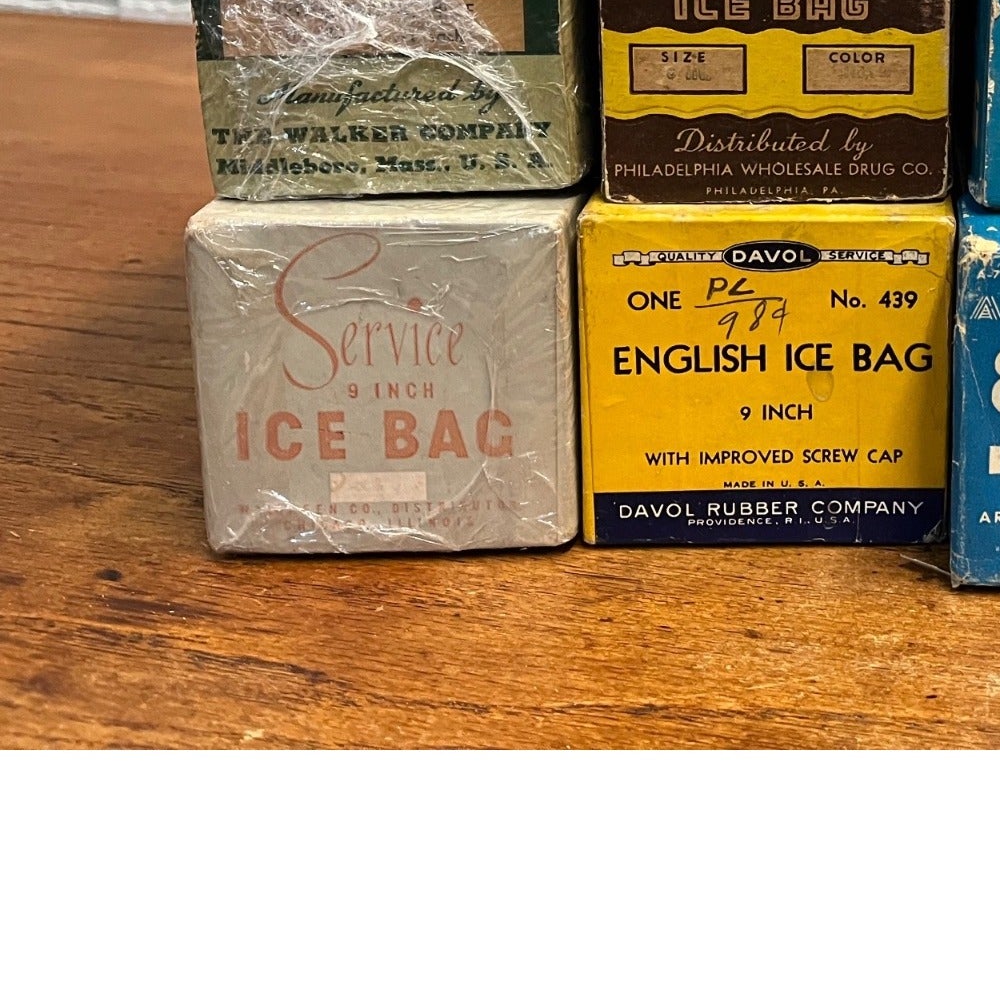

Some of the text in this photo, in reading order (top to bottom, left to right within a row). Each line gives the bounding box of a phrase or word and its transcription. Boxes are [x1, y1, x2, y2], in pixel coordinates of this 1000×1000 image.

[661, 52, 706, 63] SIZE
[829, 52, 885, 63] COLOR
[463, 80, 501, 115] by
[286, 122, 551, 143] WALKER COMPANY
[674, 128, 874, 160] Distributed by
[615, 163, 933, 176] PHILADELPHIA WHOLESALE DRUG CO.
[657, 249, 886, 264] QUALITY DAVOL SERVICE
[628, 291, 681, 310] ONE
[830, 290, 918, 308] No. 439
[275, 232, 464, 390] Service
[614, 343, 932, 376] ENGLISH ICE BAG
[348, 383, 435, 398] 9 INCH
[740, 404, 813, 421] 9 INCH
[235, 410, 513, 461] ICE BAG
[645, 449, 903, 466] WITH IMPROVED SCREW CAP
[619, 501, 924, 519] DAVOL RUBBER COMPANY
